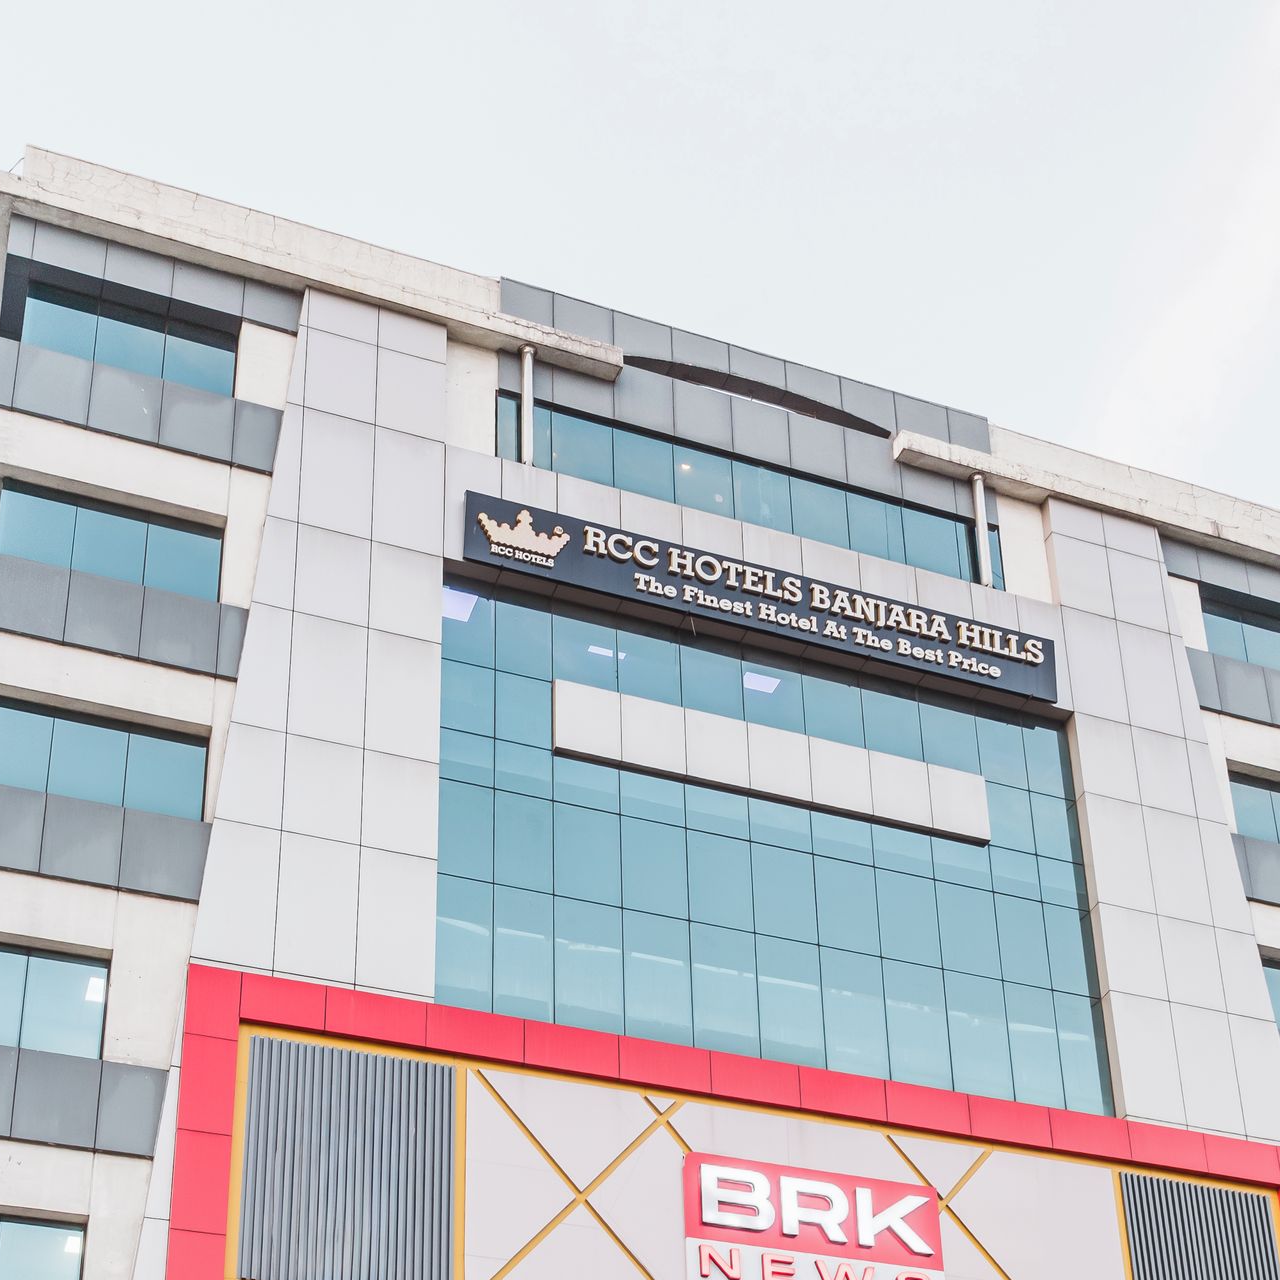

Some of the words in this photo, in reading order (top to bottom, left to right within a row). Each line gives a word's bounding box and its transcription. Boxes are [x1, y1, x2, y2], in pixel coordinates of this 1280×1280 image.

[490, 543, 514, 557] RCC
[514, 549, 555, 568] HOTELS
[584, 525, 660, 569] RCC
[668, 546, 803, 604] HOTELS
[809, 582, 953, 642] BANJARA
[956, 619, 1045, 665] HILLS
[634, 572, 677, 598] The
[682, 584, 753, 618] Finest
[758, 602, 819, 634] Hotel
[823, 619, 848, 640] At
[852, 626, 893, 651] The
[897, 637, 945, 664] Best
[947, 650, 1002, 678] Price
[699, 1162, 935, 1258] BRK
